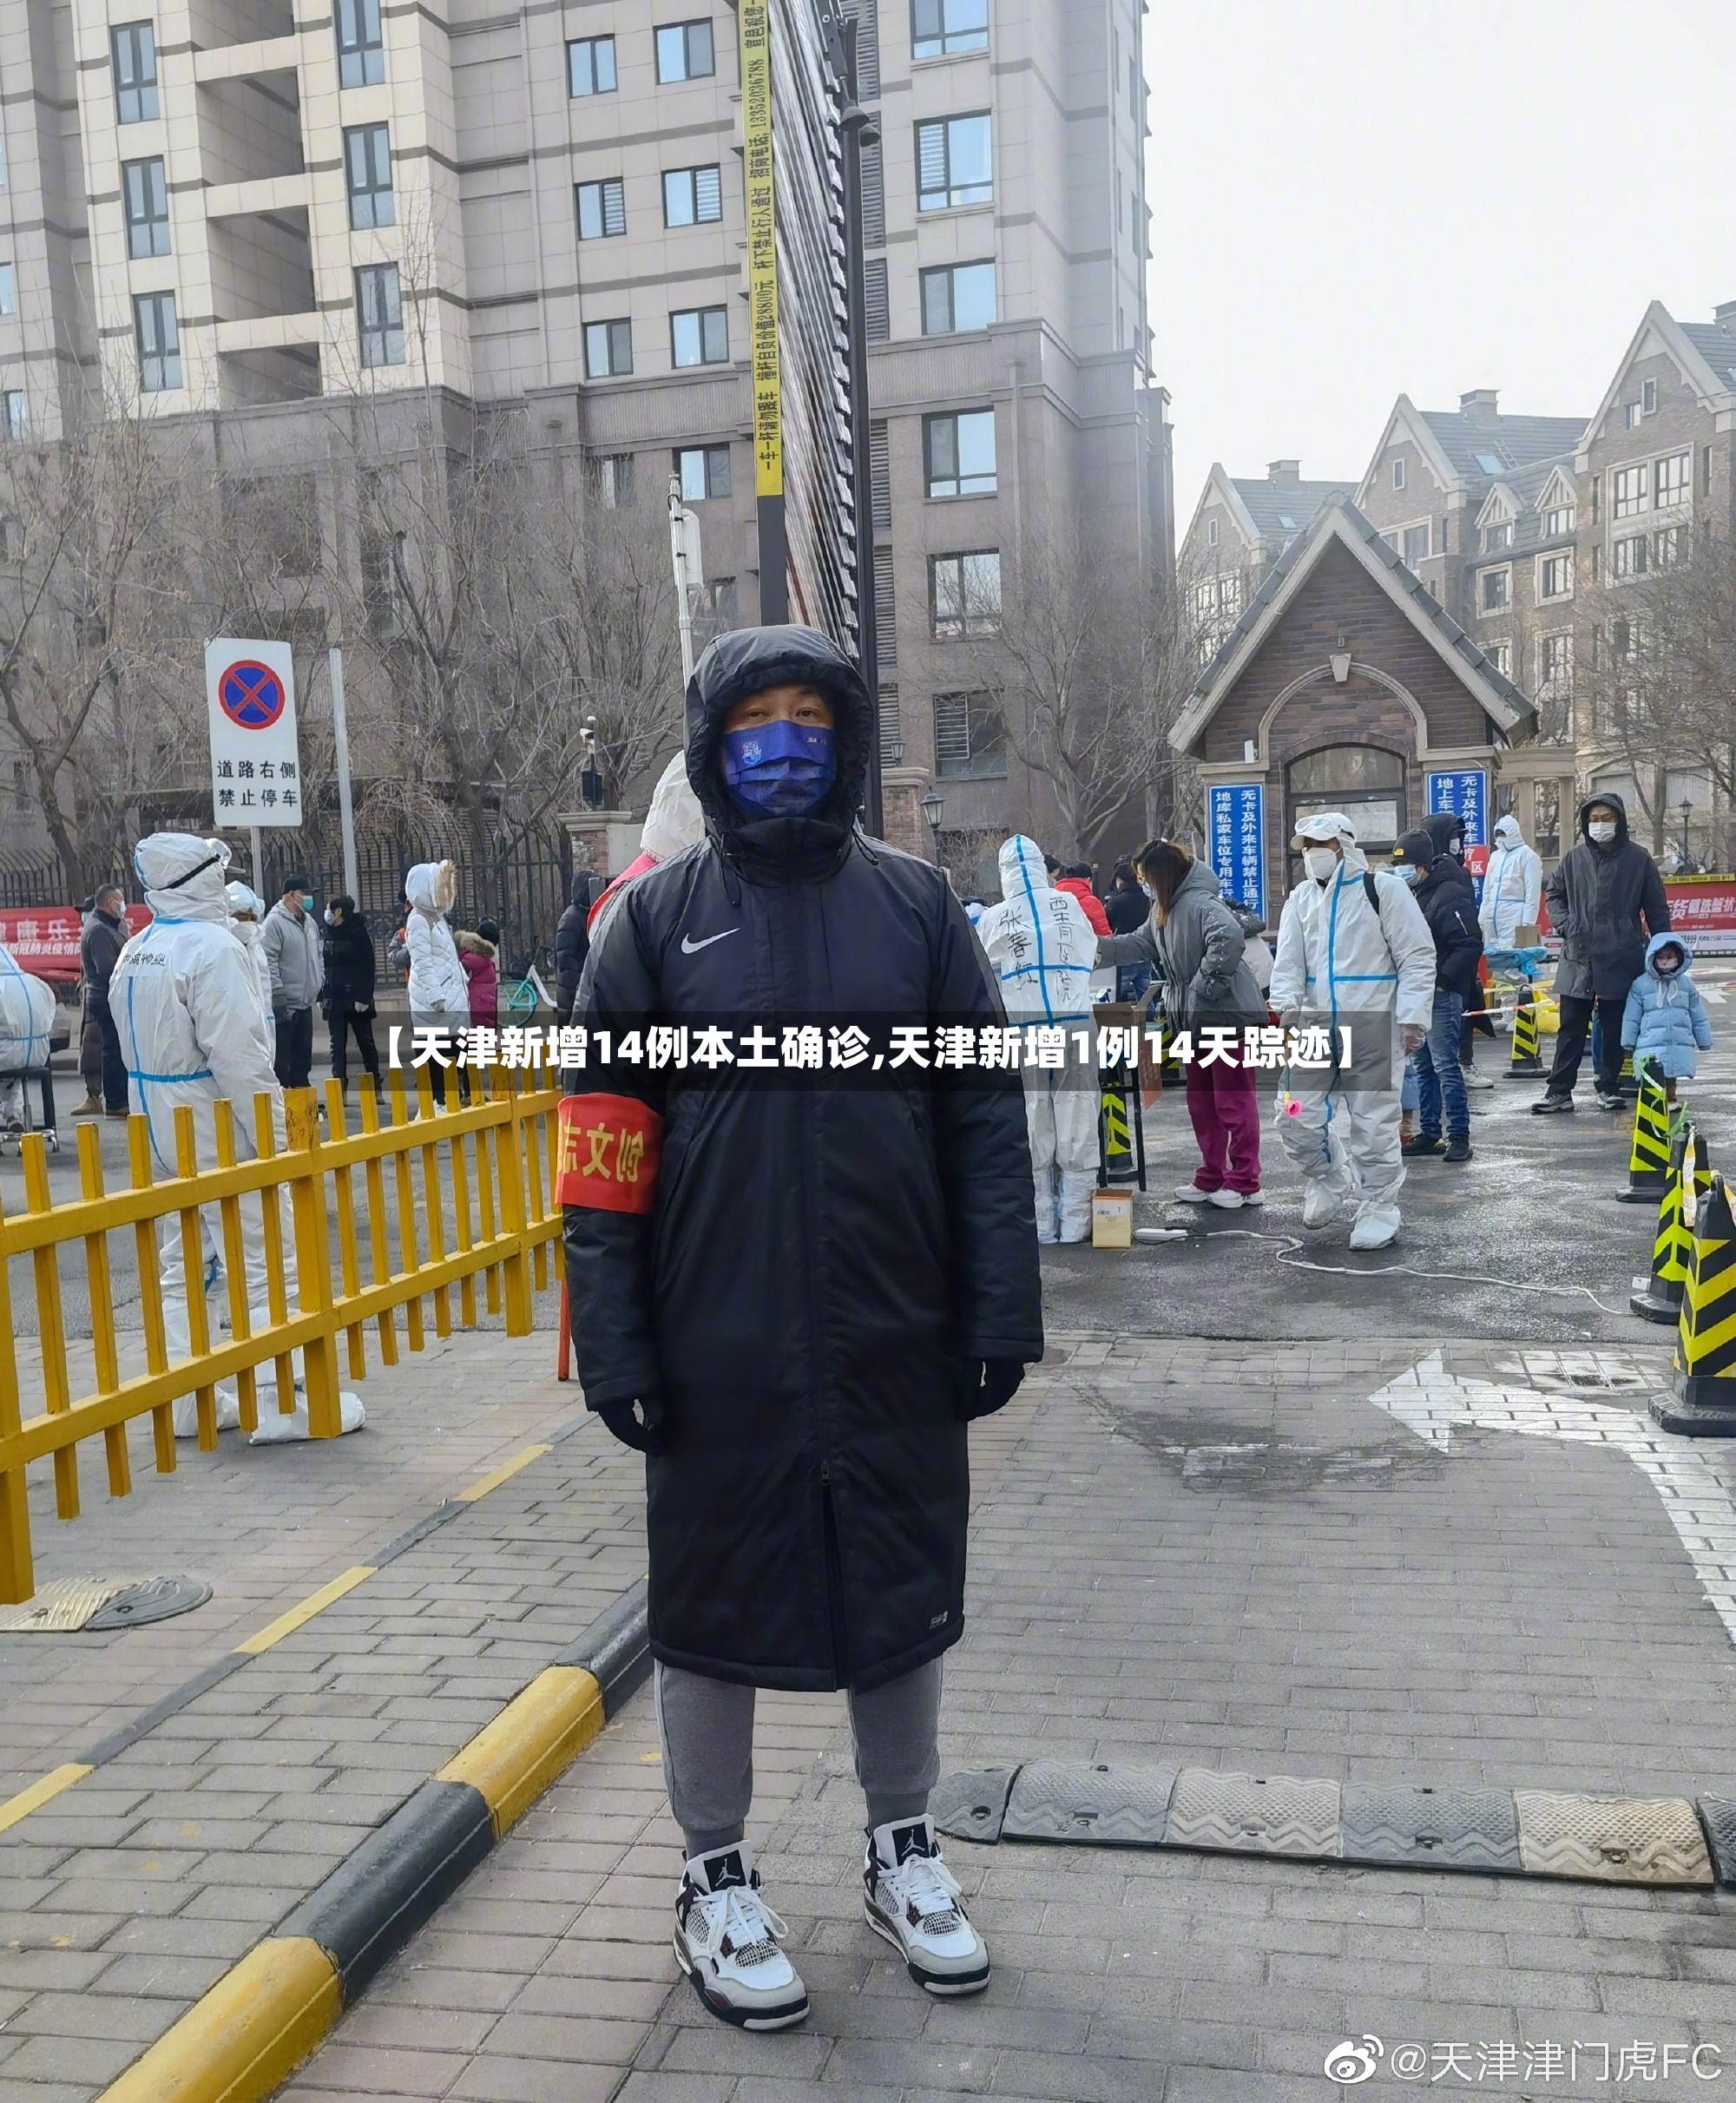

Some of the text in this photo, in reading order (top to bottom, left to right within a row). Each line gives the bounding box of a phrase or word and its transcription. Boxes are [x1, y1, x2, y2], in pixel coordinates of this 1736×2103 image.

[746, 58, 766, 128] 13352036788
[751, 186, 774, 270] 杆下禁止行人通过
[756, 391, 779, 470] 一车一杆请勿跟车
[217, 759, 296, 779] 道路右侧
[219, 788, 298, 807] 禁止停车
[1437, 777, 1454, 815] 地上车
[1240, 789, 1259, 910] 无卡及外来车辆禁止通行
